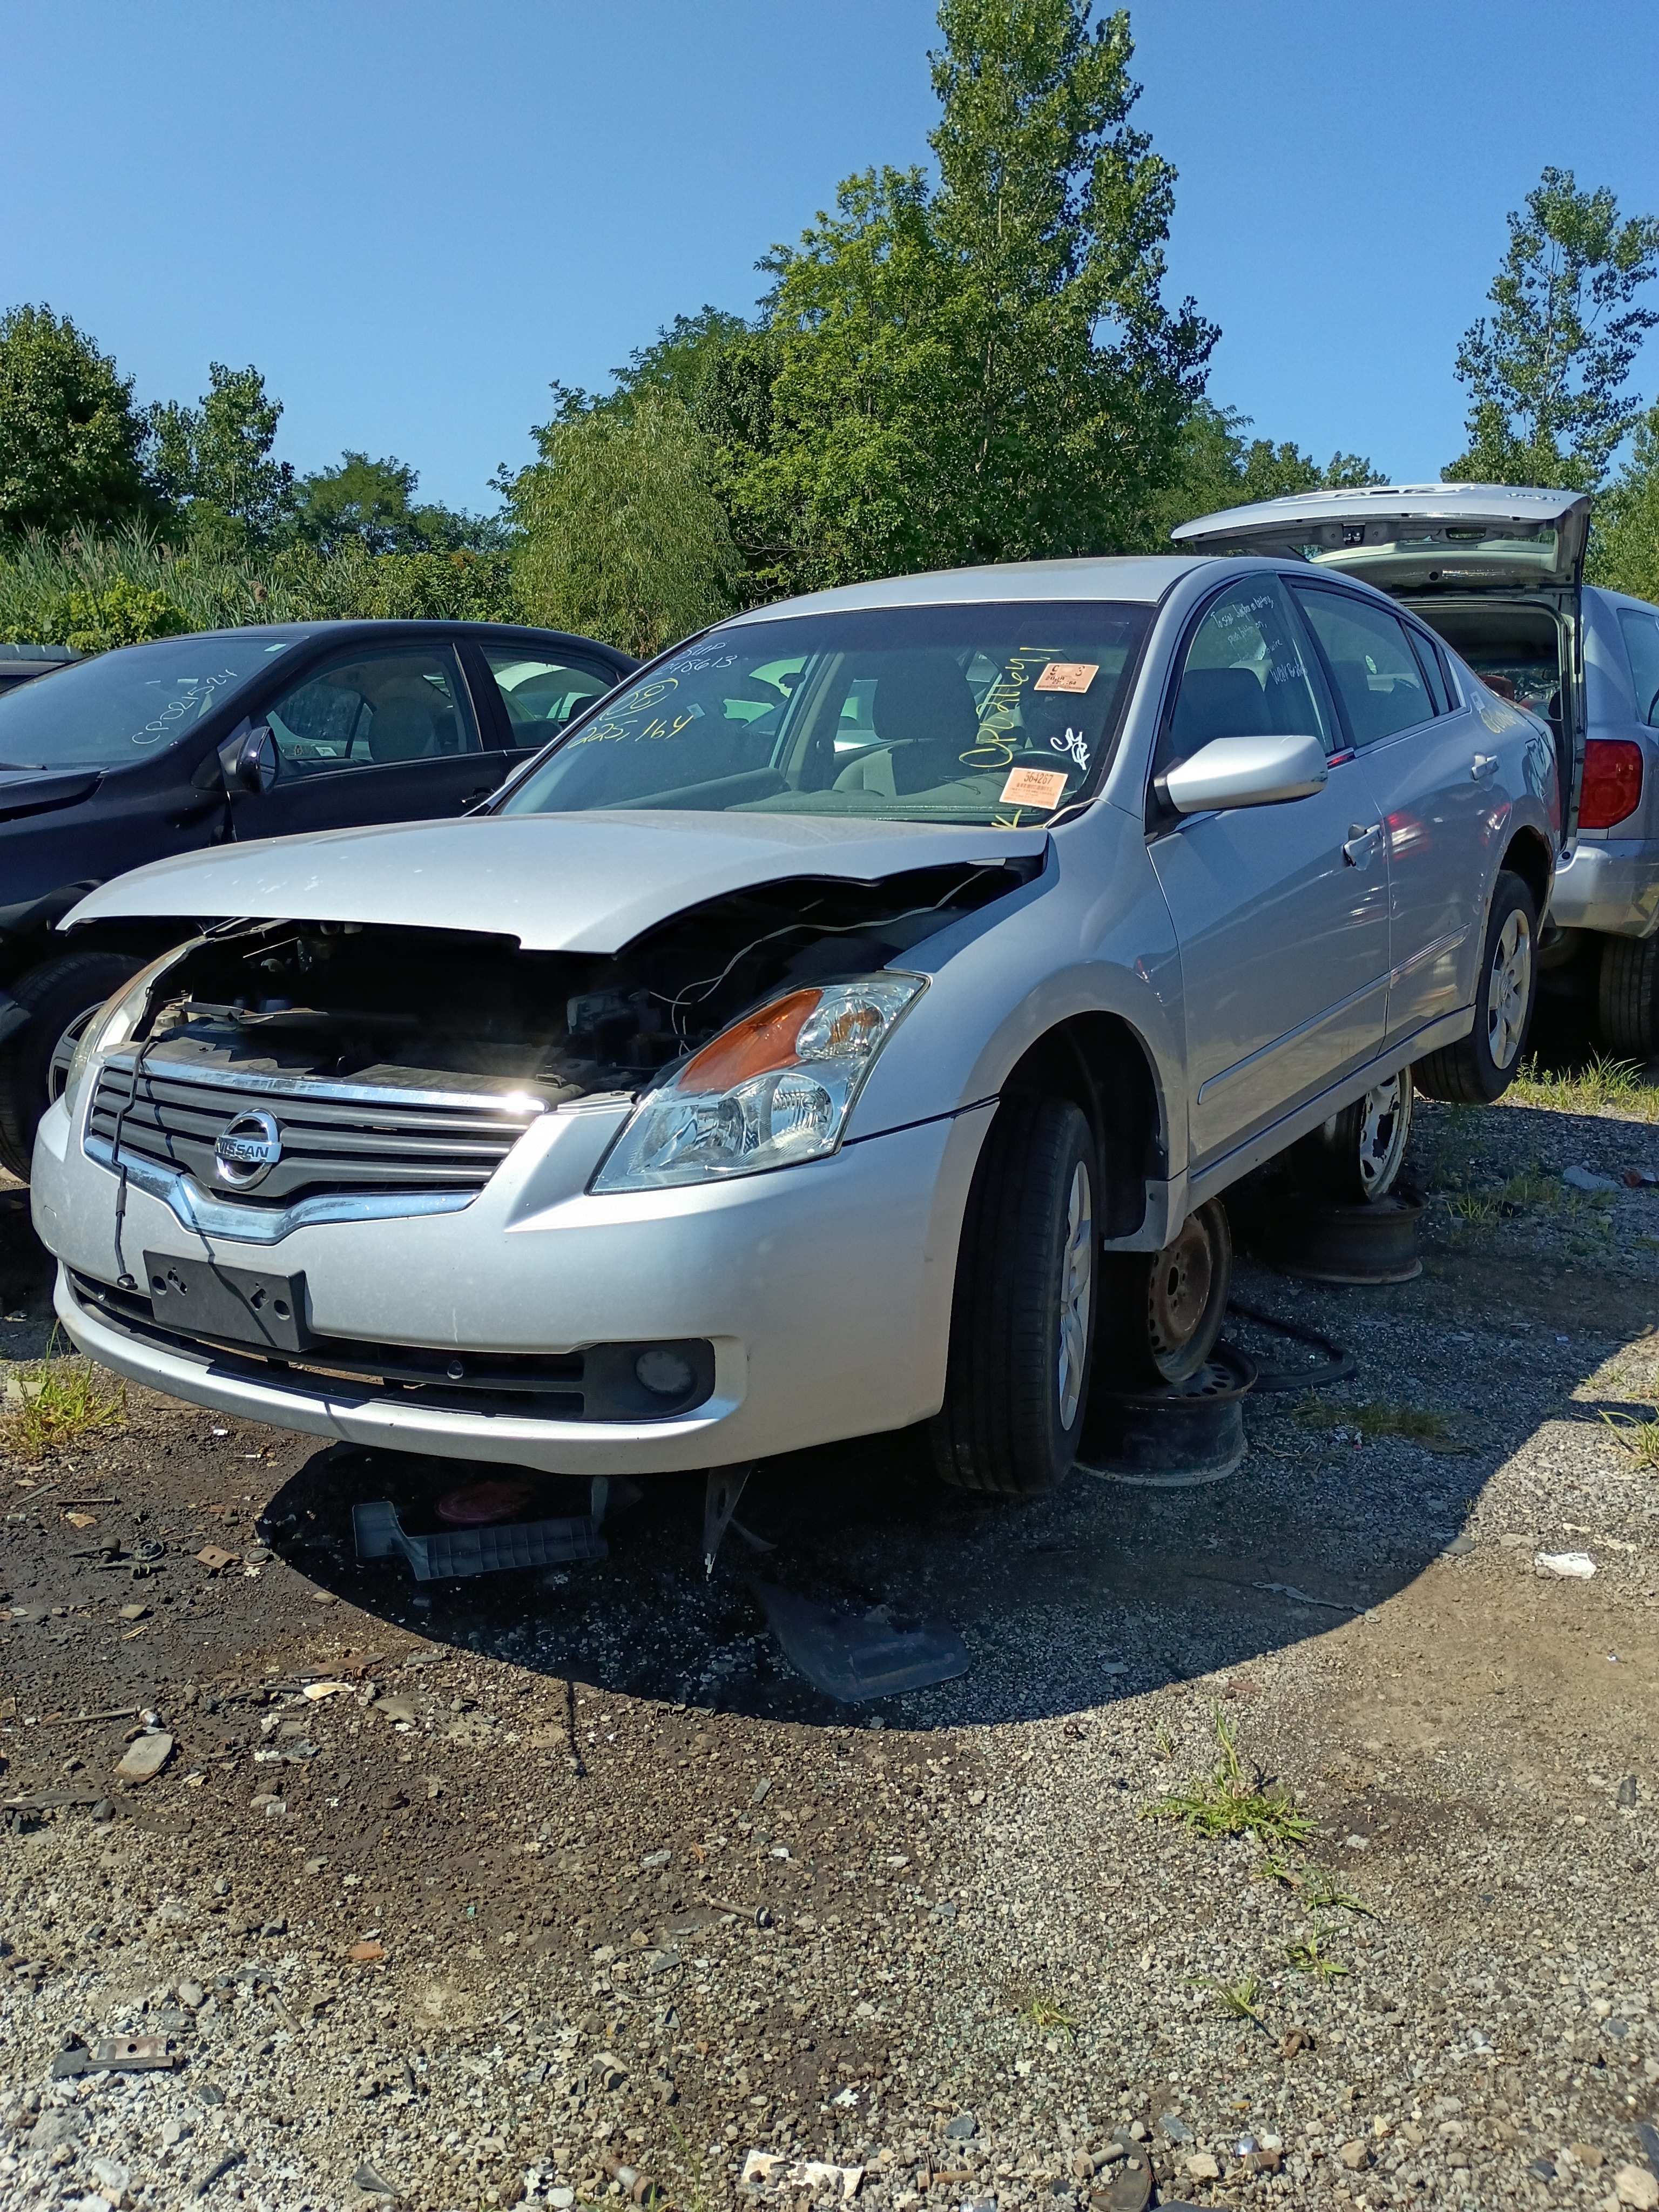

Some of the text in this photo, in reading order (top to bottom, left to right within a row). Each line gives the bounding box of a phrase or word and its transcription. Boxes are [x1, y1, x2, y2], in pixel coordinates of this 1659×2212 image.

[131, 669, 238, 744] CP021524
[1023, 771, 1054, 785] 564267
[216, 1141, 269, 1158] NISSAN
